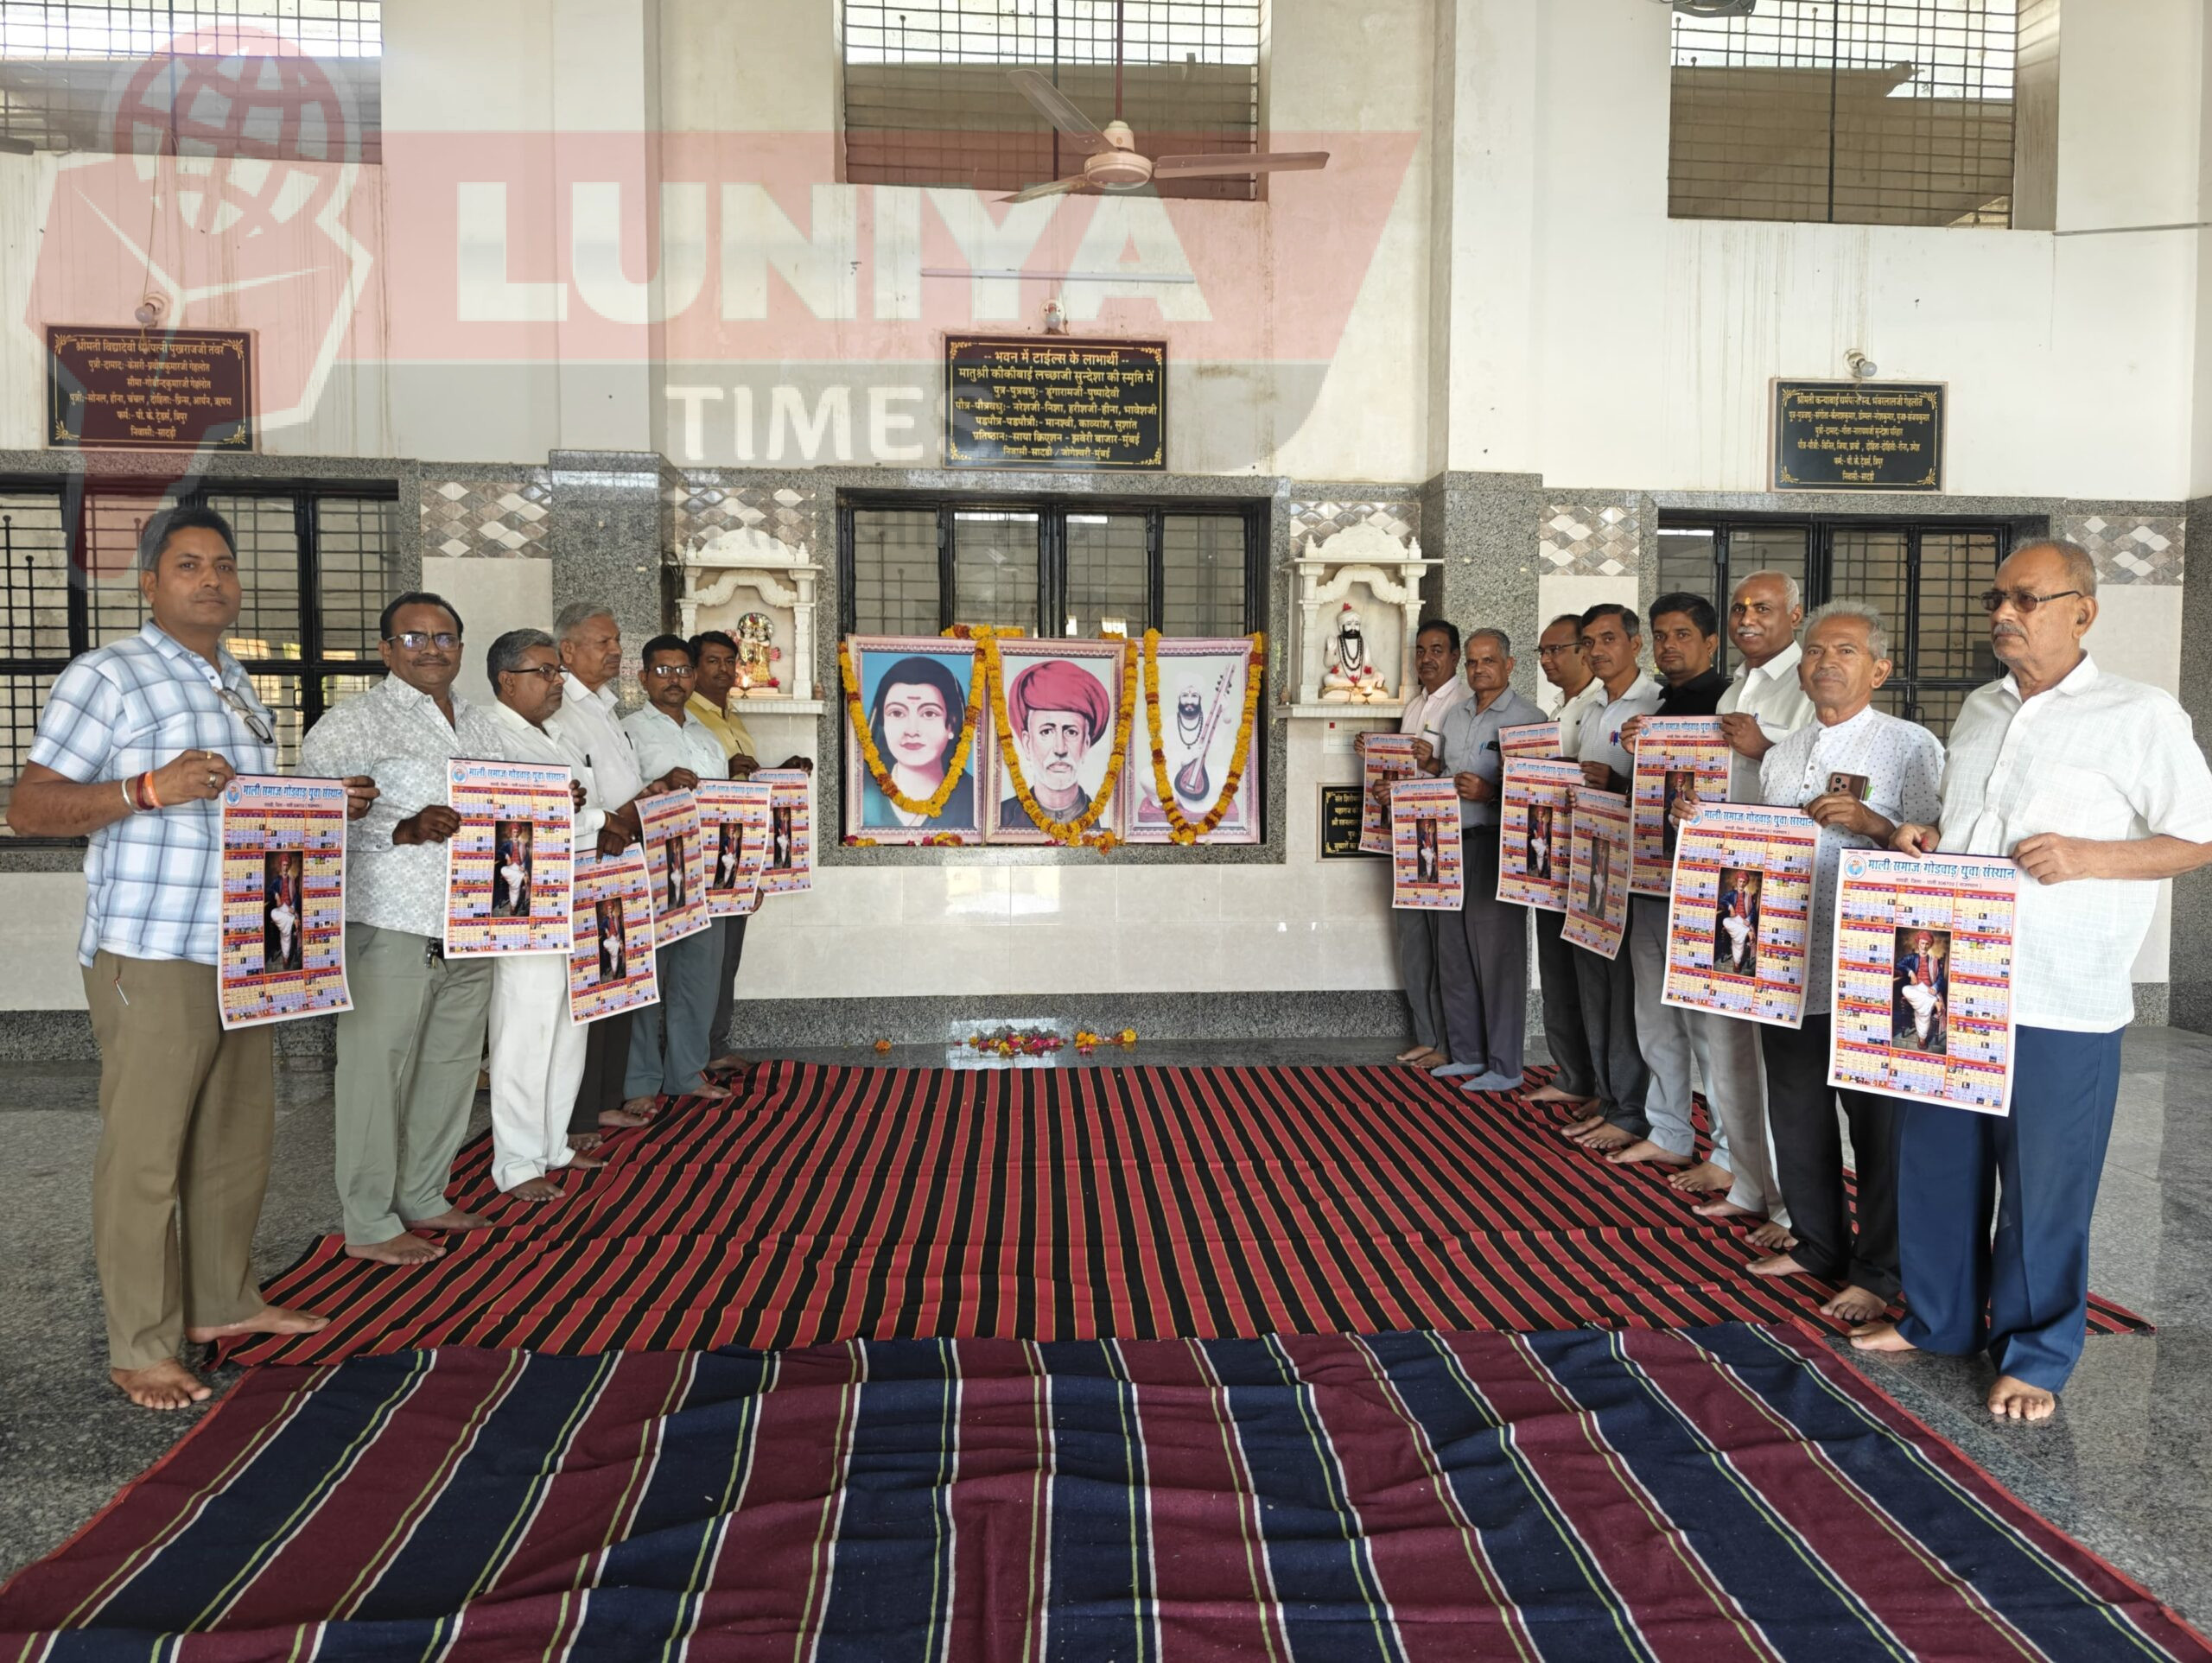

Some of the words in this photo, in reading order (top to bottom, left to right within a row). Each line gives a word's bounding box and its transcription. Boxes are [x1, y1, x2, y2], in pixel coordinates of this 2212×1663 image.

[76, 339, 101, 352] श्रीमती
[995, 352, 1018, 364] भवन
[1033, 352, 1066, 365] टाईल्स
[1070, 351, 1079, 365] के
[1083, 352, 1118, 366] लाभार्थी
[958, 365, 988, 383] मातुश्री
[991, 366, 1032, 381] कीकीबाई
[1035, 368, 1071, 381] लच्छाजी
[1075, 369, 1104, 384] सुन्देशा
[1107, 370, 1119, 382] की
[1122, 370, 1143, 386] स्मृति
[1124, 403, 1157, 415] भावेशजी
[1115, 419, 1137, 430] सुशांत
[243, 783, 260, 796] माली
[309, 788, 320, 801] युवा
[1704, 809, 1720, 820] माली
[1723, 811, 1743, 821] समाज
[1773, 816, 1787, 827] युवा
[1789, 815, 1814, 827] संस्थान
[1868, 857, 1890, 872] माली
[1893, 860, 1919, 873] समाज
[1923, 861, 1956, 876] गोडवाड़
[1961, 866, 1980, 879] युवा
[1982, 864, 2015, 879] संस्थान
